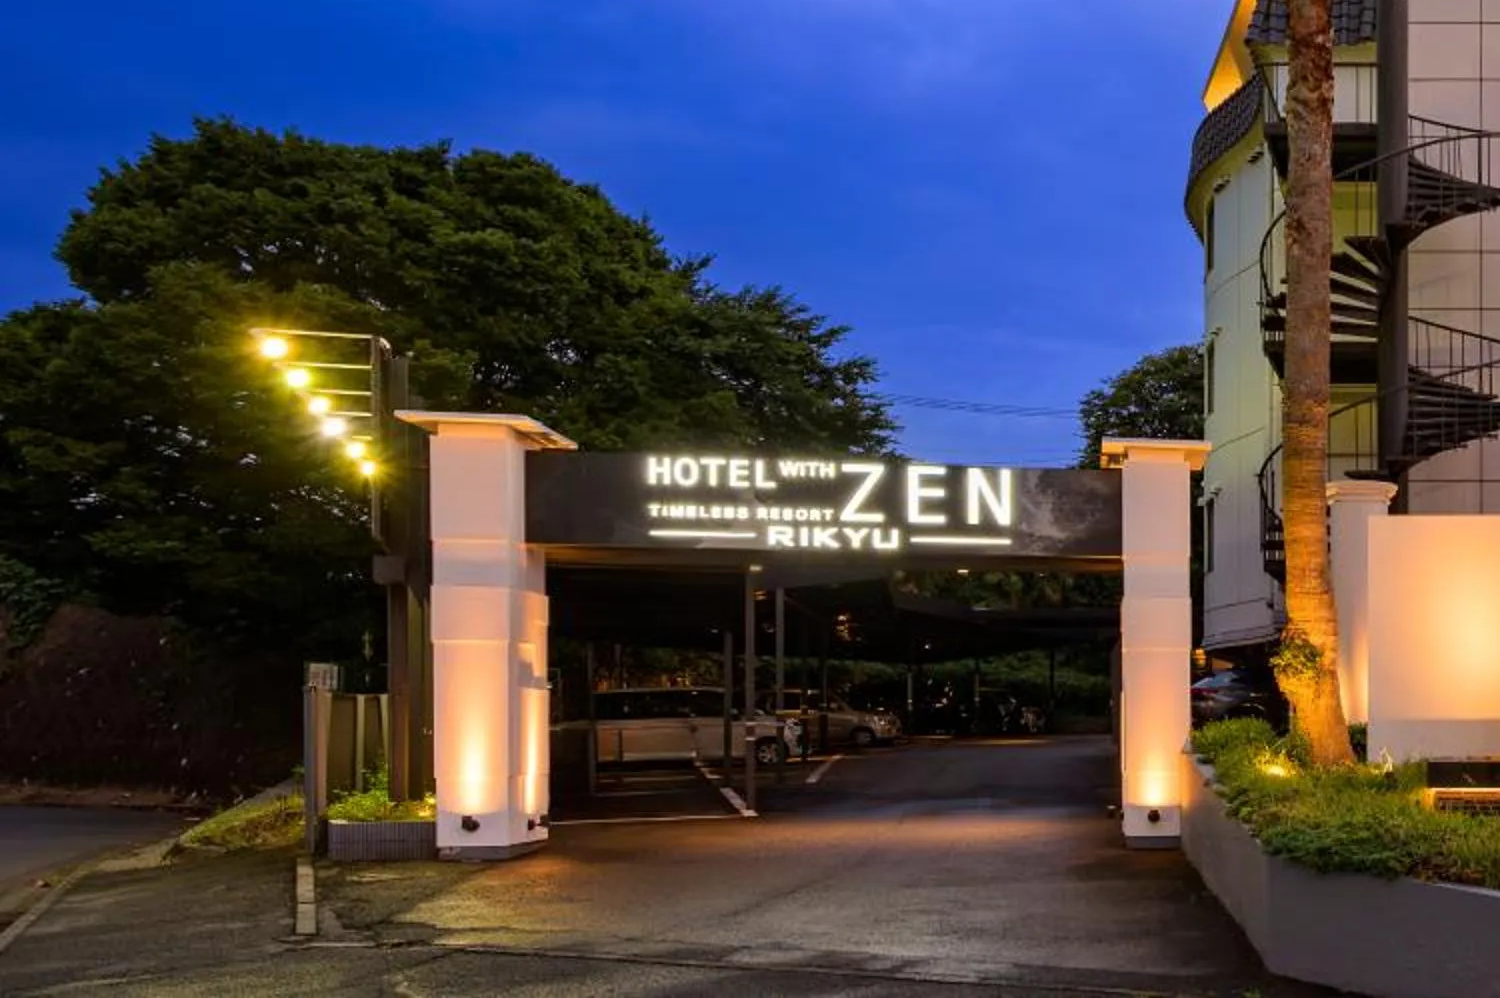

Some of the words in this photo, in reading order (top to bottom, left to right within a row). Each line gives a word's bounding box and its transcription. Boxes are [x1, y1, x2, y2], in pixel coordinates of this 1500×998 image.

[645, 456, 777, 490] HOTEL
[778, 459, 836, 480] WITH
[838, 462, 1013, 527] ZEN
[647, 503, 750, 521] TIMELESS
[754, 505, 836, 523] RESORT
[765, 524, 900, 550] RIKYU
